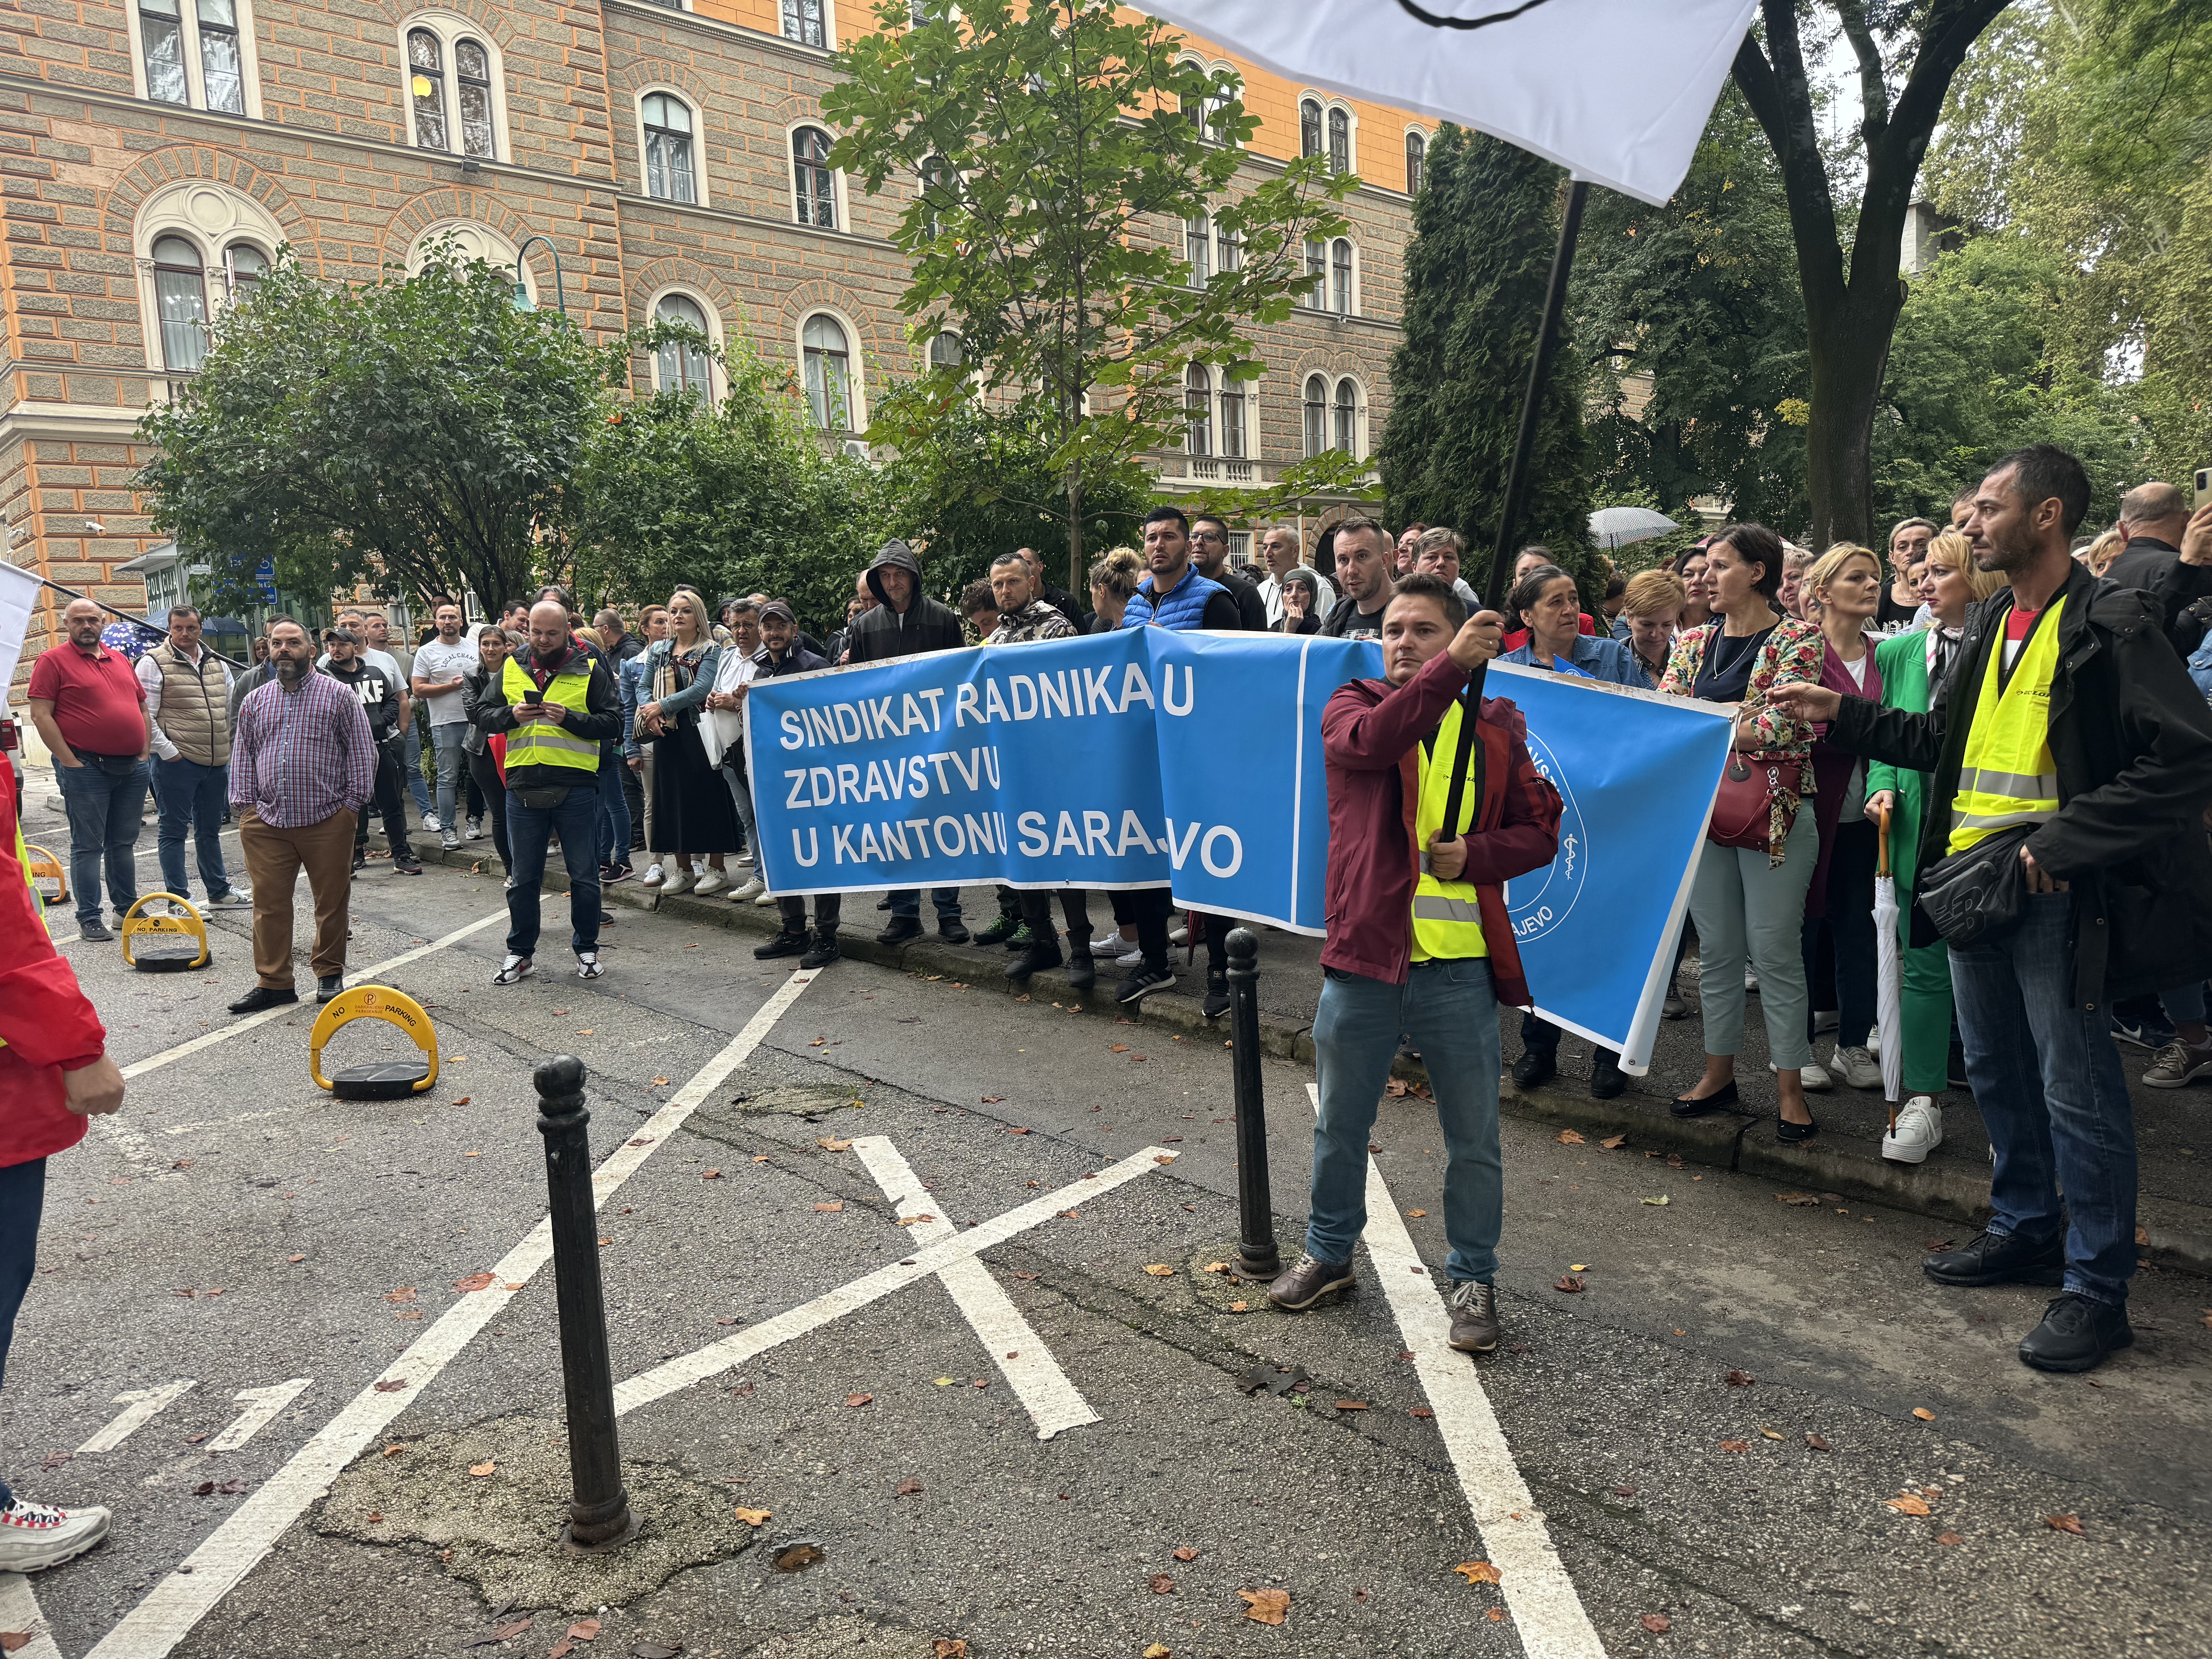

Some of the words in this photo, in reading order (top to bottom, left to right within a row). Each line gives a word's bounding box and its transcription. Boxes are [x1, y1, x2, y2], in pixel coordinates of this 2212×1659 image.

[441, 654, 456, 667] LOCAL
[780, 688, 944, 750] SINDIKAT
[956, 663, 1154, 727] RADNIKA
[1163, 664, 1193, 716] U
[785, 746, 1000, 809] ZDRAVSTVU
[792, 828, 818, 867] U
[833, 812, 1007, 864] KANTONU
[1018, 810, 1242, 878] SARAVO
[1511, 906, 1553, 936] AJEVO
[332, 1007, 345, 1018] NO
[385, 1005, 416, 1027] PARKING
